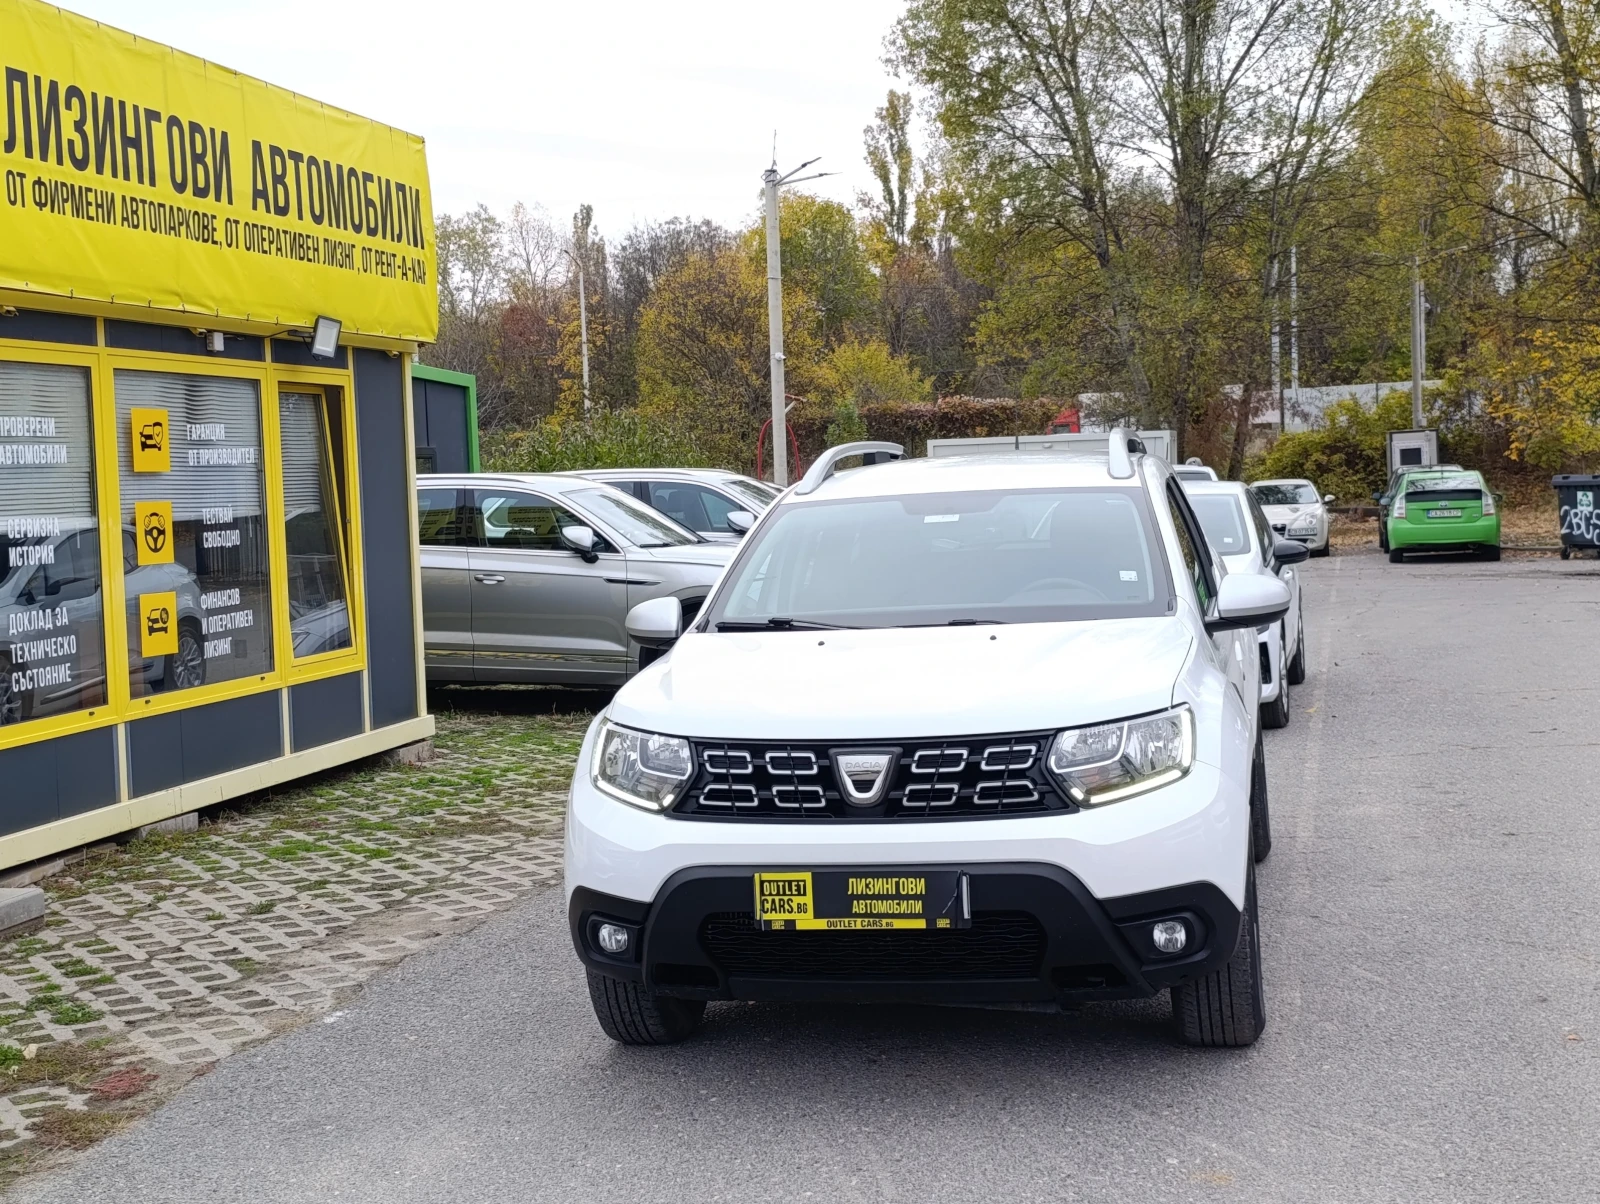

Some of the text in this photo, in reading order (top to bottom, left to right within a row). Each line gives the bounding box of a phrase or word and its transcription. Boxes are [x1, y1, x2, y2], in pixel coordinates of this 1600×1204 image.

[4, 66, 425, 250] ЛИЗИНГОВИ АВТОМОБИЛИ
[6, 169, 26, 208] ОТ
[31, 176, 117, 226] ФИРМЕНИ
[120, 195, 223, 250] АВТОПАРКОВЕ,
[225, 217, 240, 250] ОТ
[243, 221, 320, 265] ОПЕРАТИВЕН
[362, 246, 373, 274] ОТ
[186, 423, 226, 442] ГАРАНЦИЯ
[0, 444, 68, 465] АВТОМОБИЛИ
[188, 447, 255, 466] ОТ ПРОИЗВОДИТЕЛ
[202, 504, 234, 525] ТЕСТВАЙ
[7, 517, 60, 539] СЕРВИЗНА
[203, 529, 241, 549] СВОБОДНО
[8, 544, 55, 568] ИСТОРИЯ
[200, 587, 241, 611] ФИНАНСОВ
[9, 606, 69, 636] ДОКЛАД ЗА
[202, 609, 254, 635] И ОПЕРАТИВЕН
[10, 634, 77, 664] ТЕХНИЧЕСКО
[204, 636, 232, 660] ЛИЗИНГ
[11, 662, 72, 693] СЪСТОЯНИЕ
[844, 761, 882, 769] DACIA
[763, 881, 805, 895] OUTLET
[847, 877, 926, 895] ЛИЗИНГОВИ
[762, 897, 808, 915] CARS.BG
[852, 899, 923, 914] АВТОМОБИЛИ
[826, 919, 894, 929] OUTLET CARS.BG
